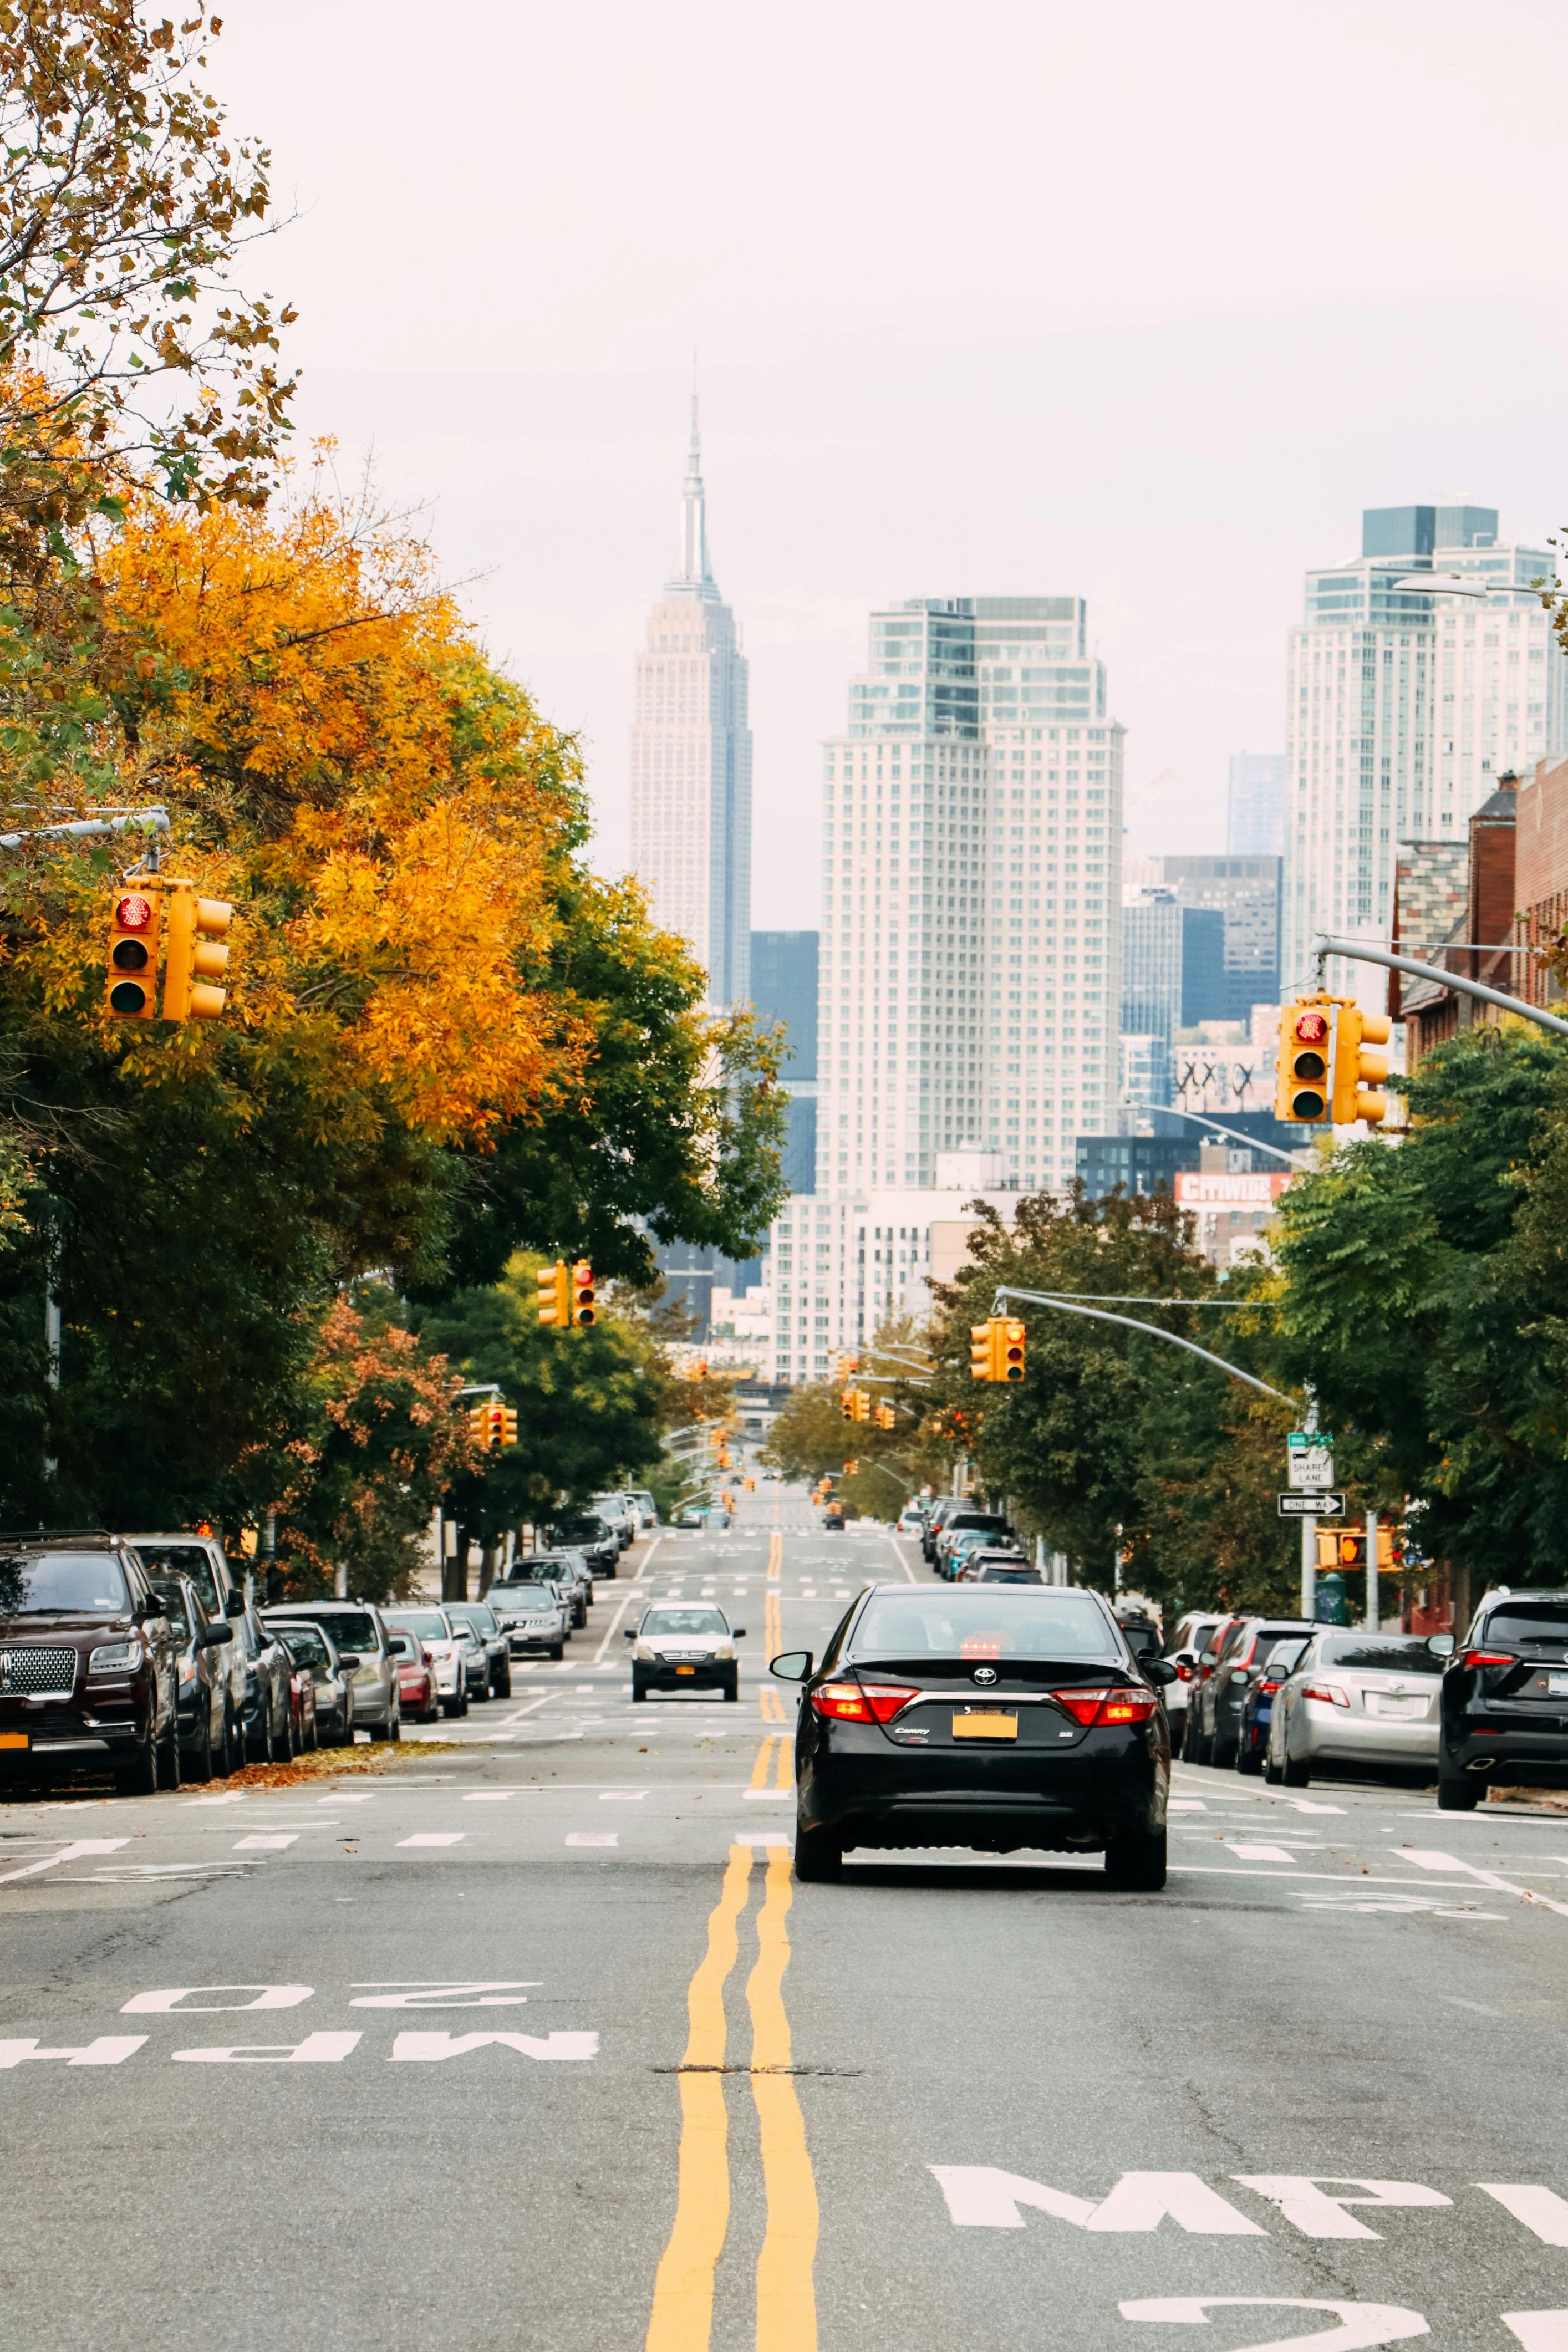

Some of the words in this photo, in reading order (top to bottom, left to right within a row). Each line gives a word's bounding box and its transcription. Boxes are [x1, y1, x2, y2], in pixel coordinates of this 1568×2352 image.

[1294, 1464, 1329, 1472] SHARED
[1300, 1474, 1323, 1483] LANE
[1289, 1501, 1307, 1509] ONE
[1315, 1501, 1333, 1509] WAY
